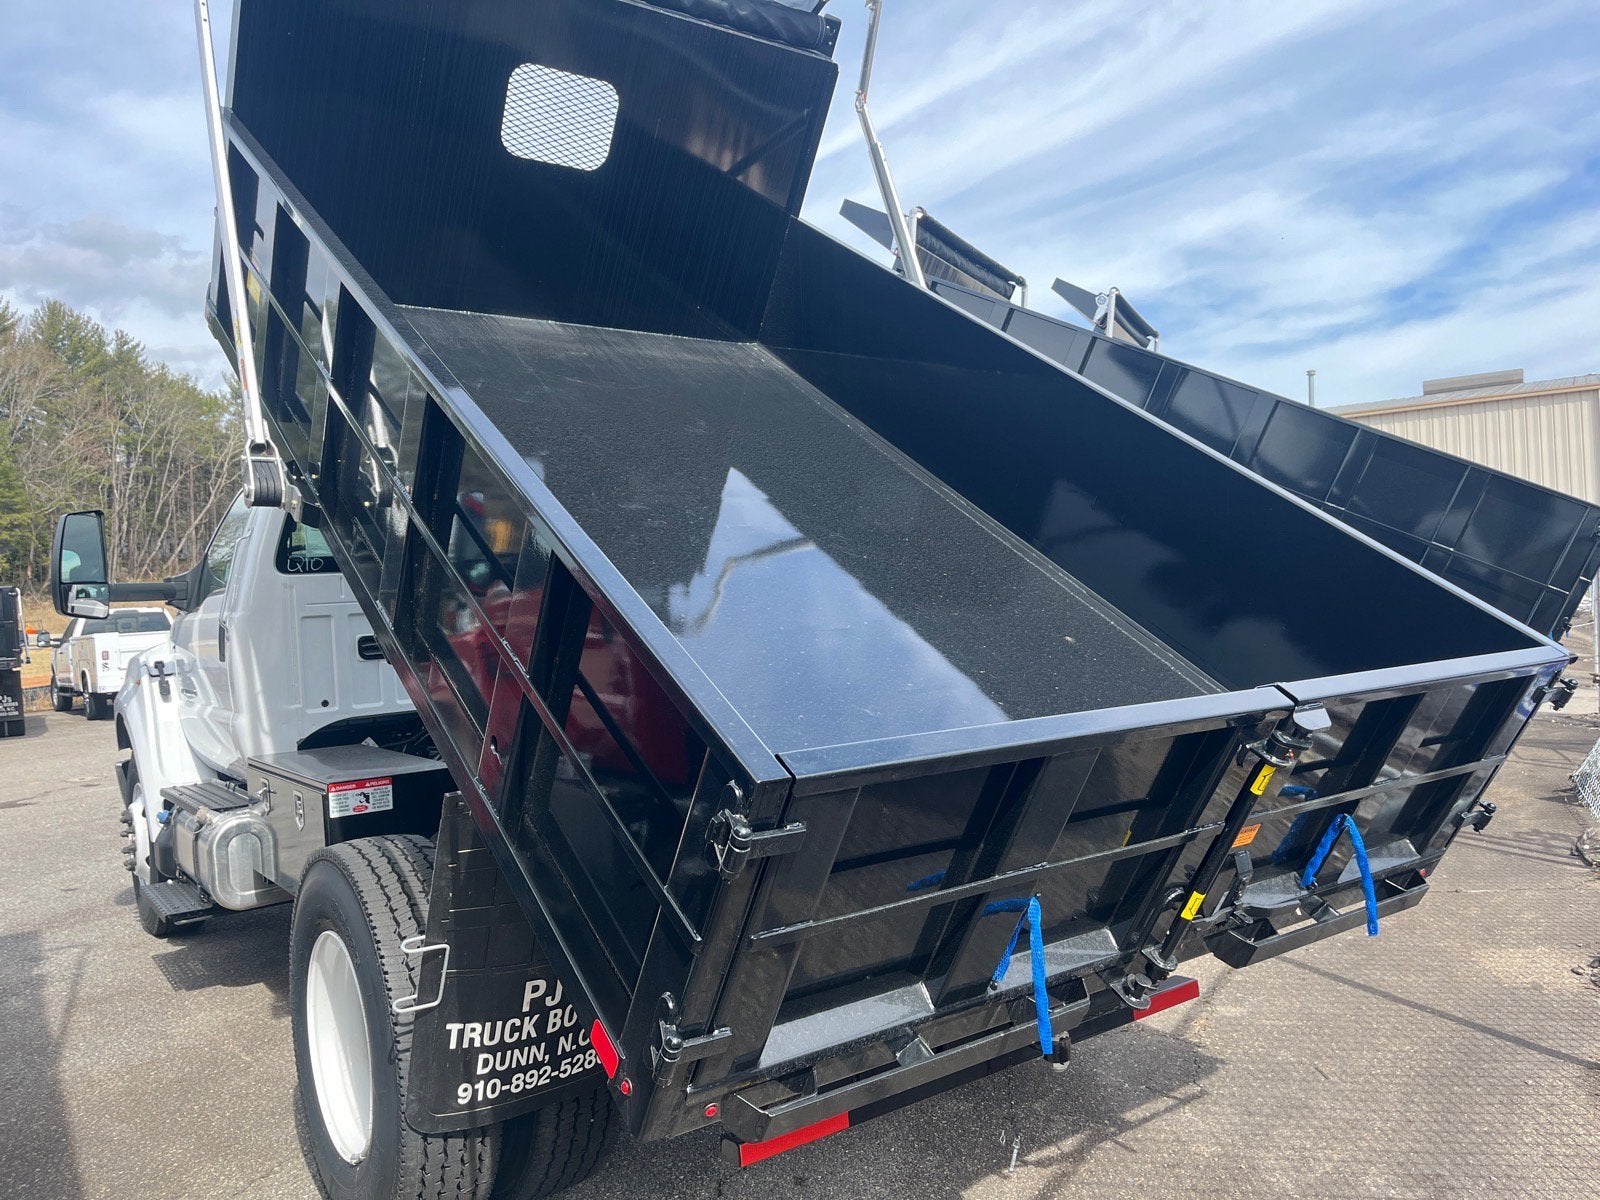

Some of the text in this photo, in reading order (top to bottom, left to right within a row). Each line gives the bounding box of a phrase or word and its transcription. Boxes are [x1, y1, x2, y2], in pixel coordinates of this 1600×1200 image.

[522, 979, 563, 1013] PJ
[446, 1004, 578, 1050] TRUCK BO
[476, 1042, 550, 1075] DUNN,
